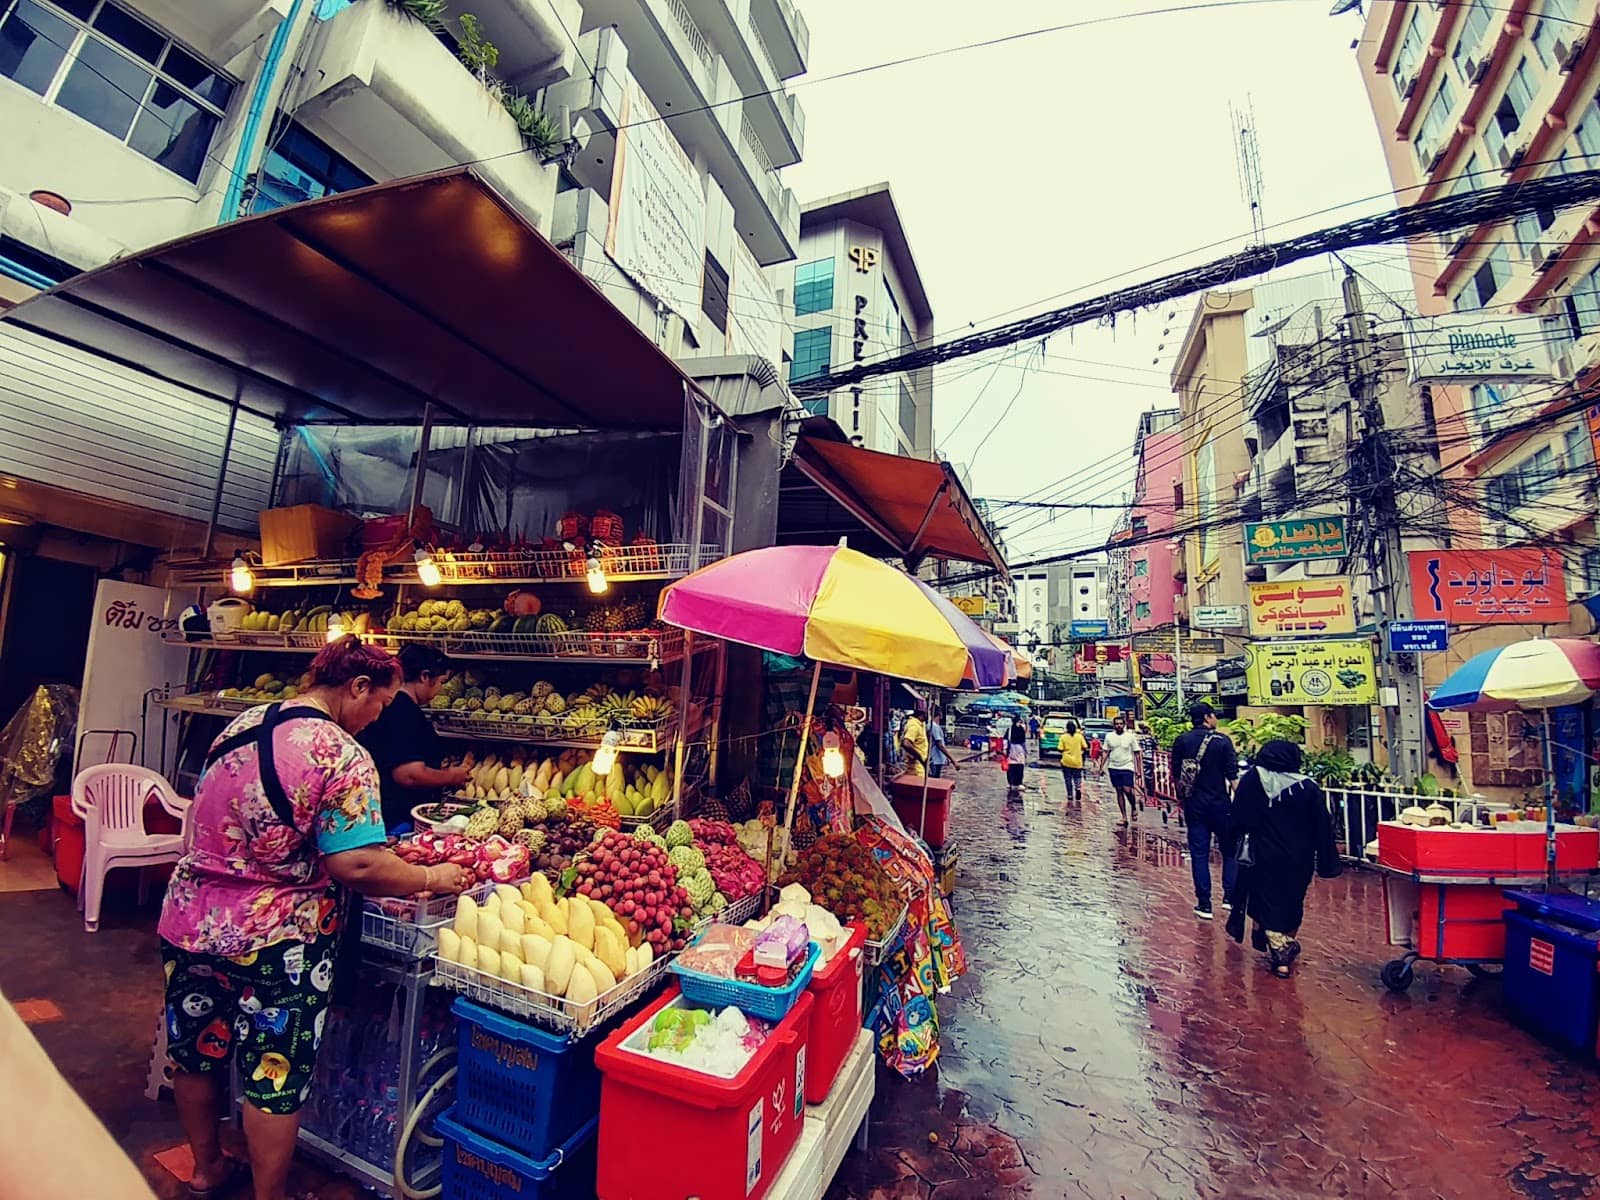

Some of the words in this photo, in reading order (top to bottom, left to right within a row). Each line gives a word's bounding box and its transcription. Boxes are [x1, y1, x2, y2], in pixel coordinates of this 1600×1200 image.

[1448, 326, 1518, 354] pinnacle
[1253, 584, 1345, 607] موسى
[1257, 603, 1346, 626] البانكوكي
[1265, 657, 1299, 670] الرحمن
[261, 1088, 297, 1100] COMPANY
